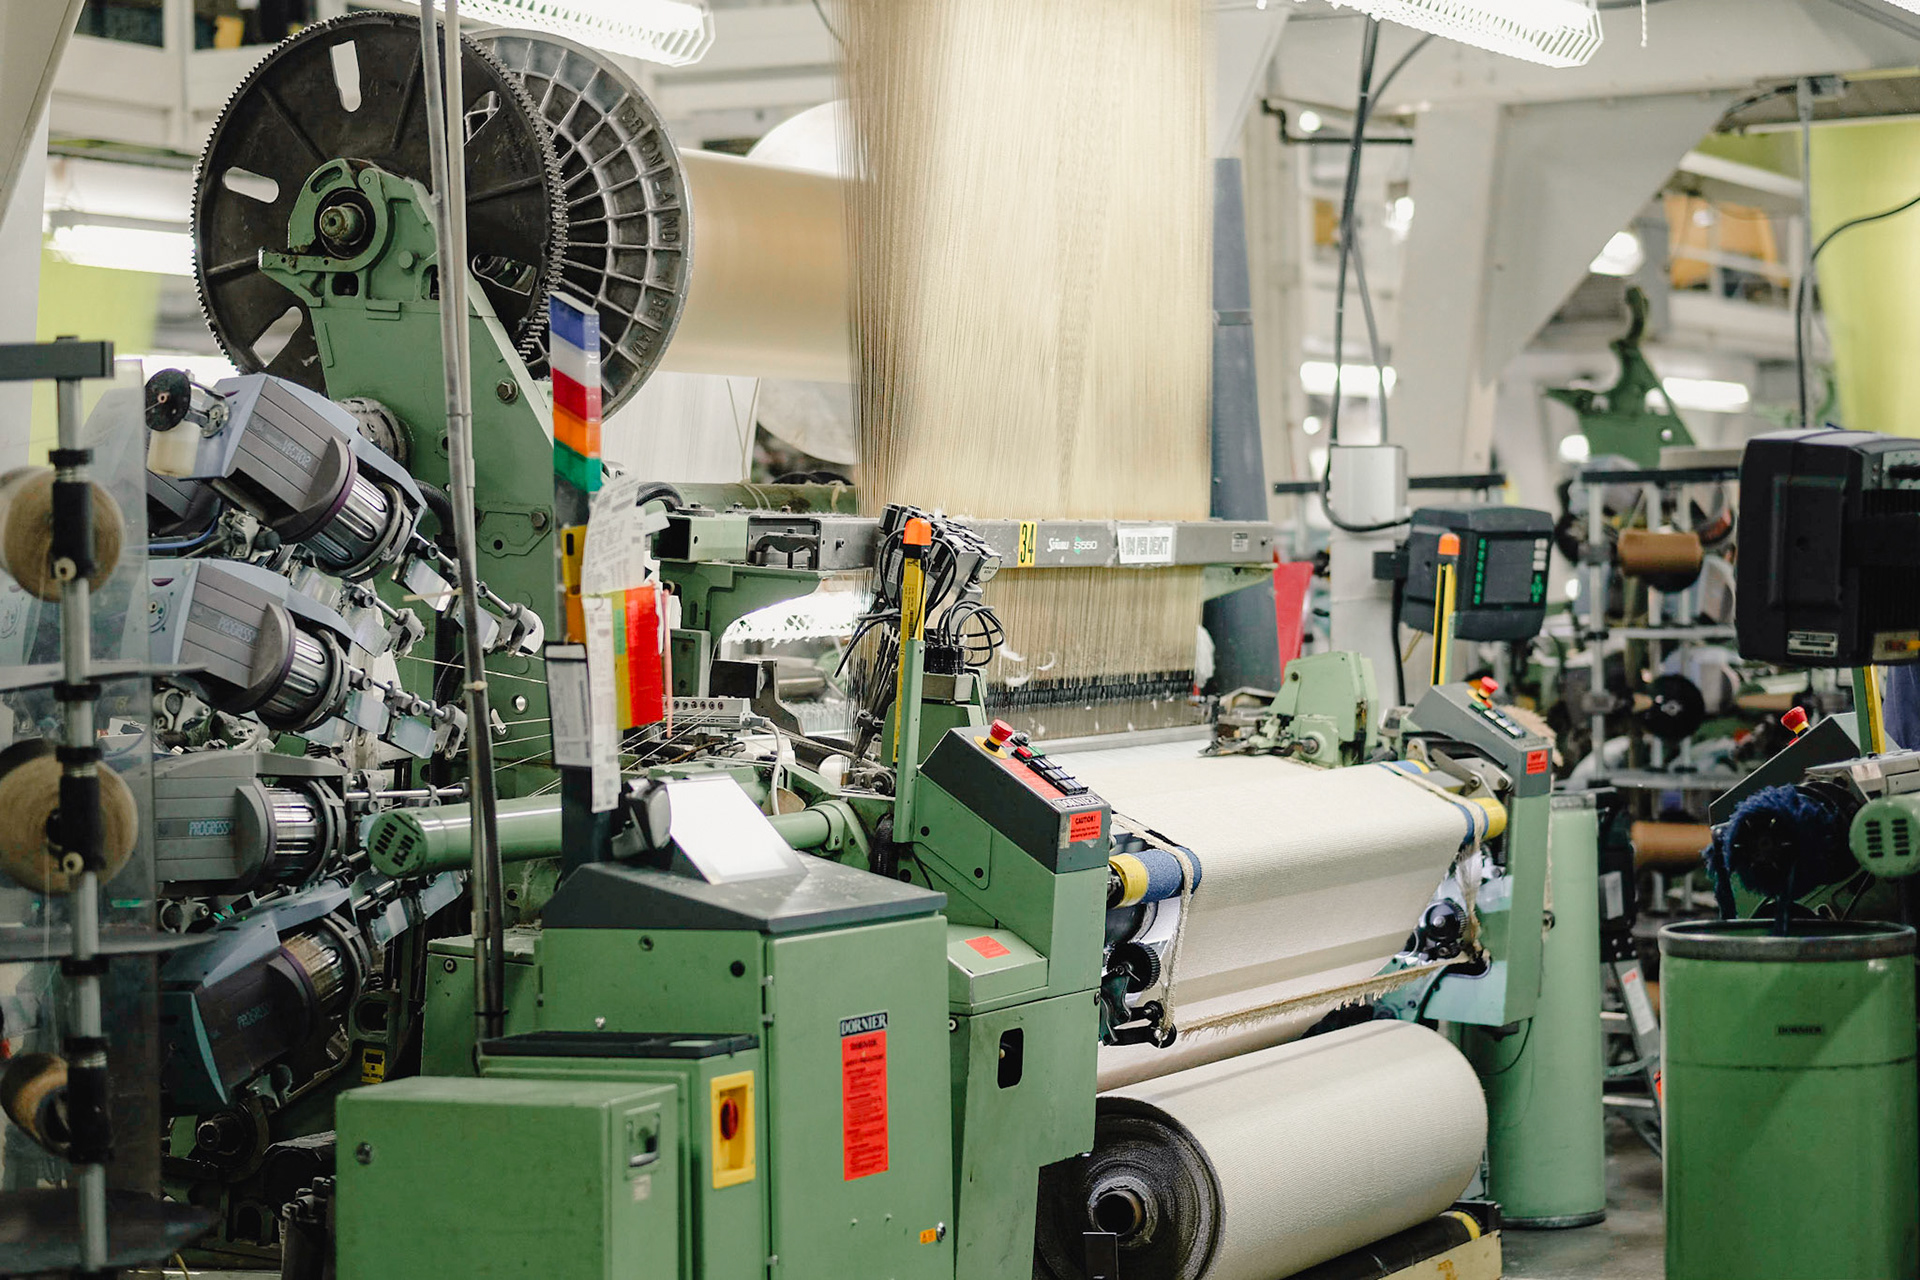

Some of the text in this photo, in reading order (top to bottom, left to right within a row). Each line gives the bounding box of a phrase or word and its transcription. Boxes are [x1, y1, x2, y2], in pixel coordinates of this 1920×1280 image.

[1020, 524, 1035, 563] 34
[189, 820, 231, 836] PROGRESS
[841, 1014, 887, 1035] DORNIER
